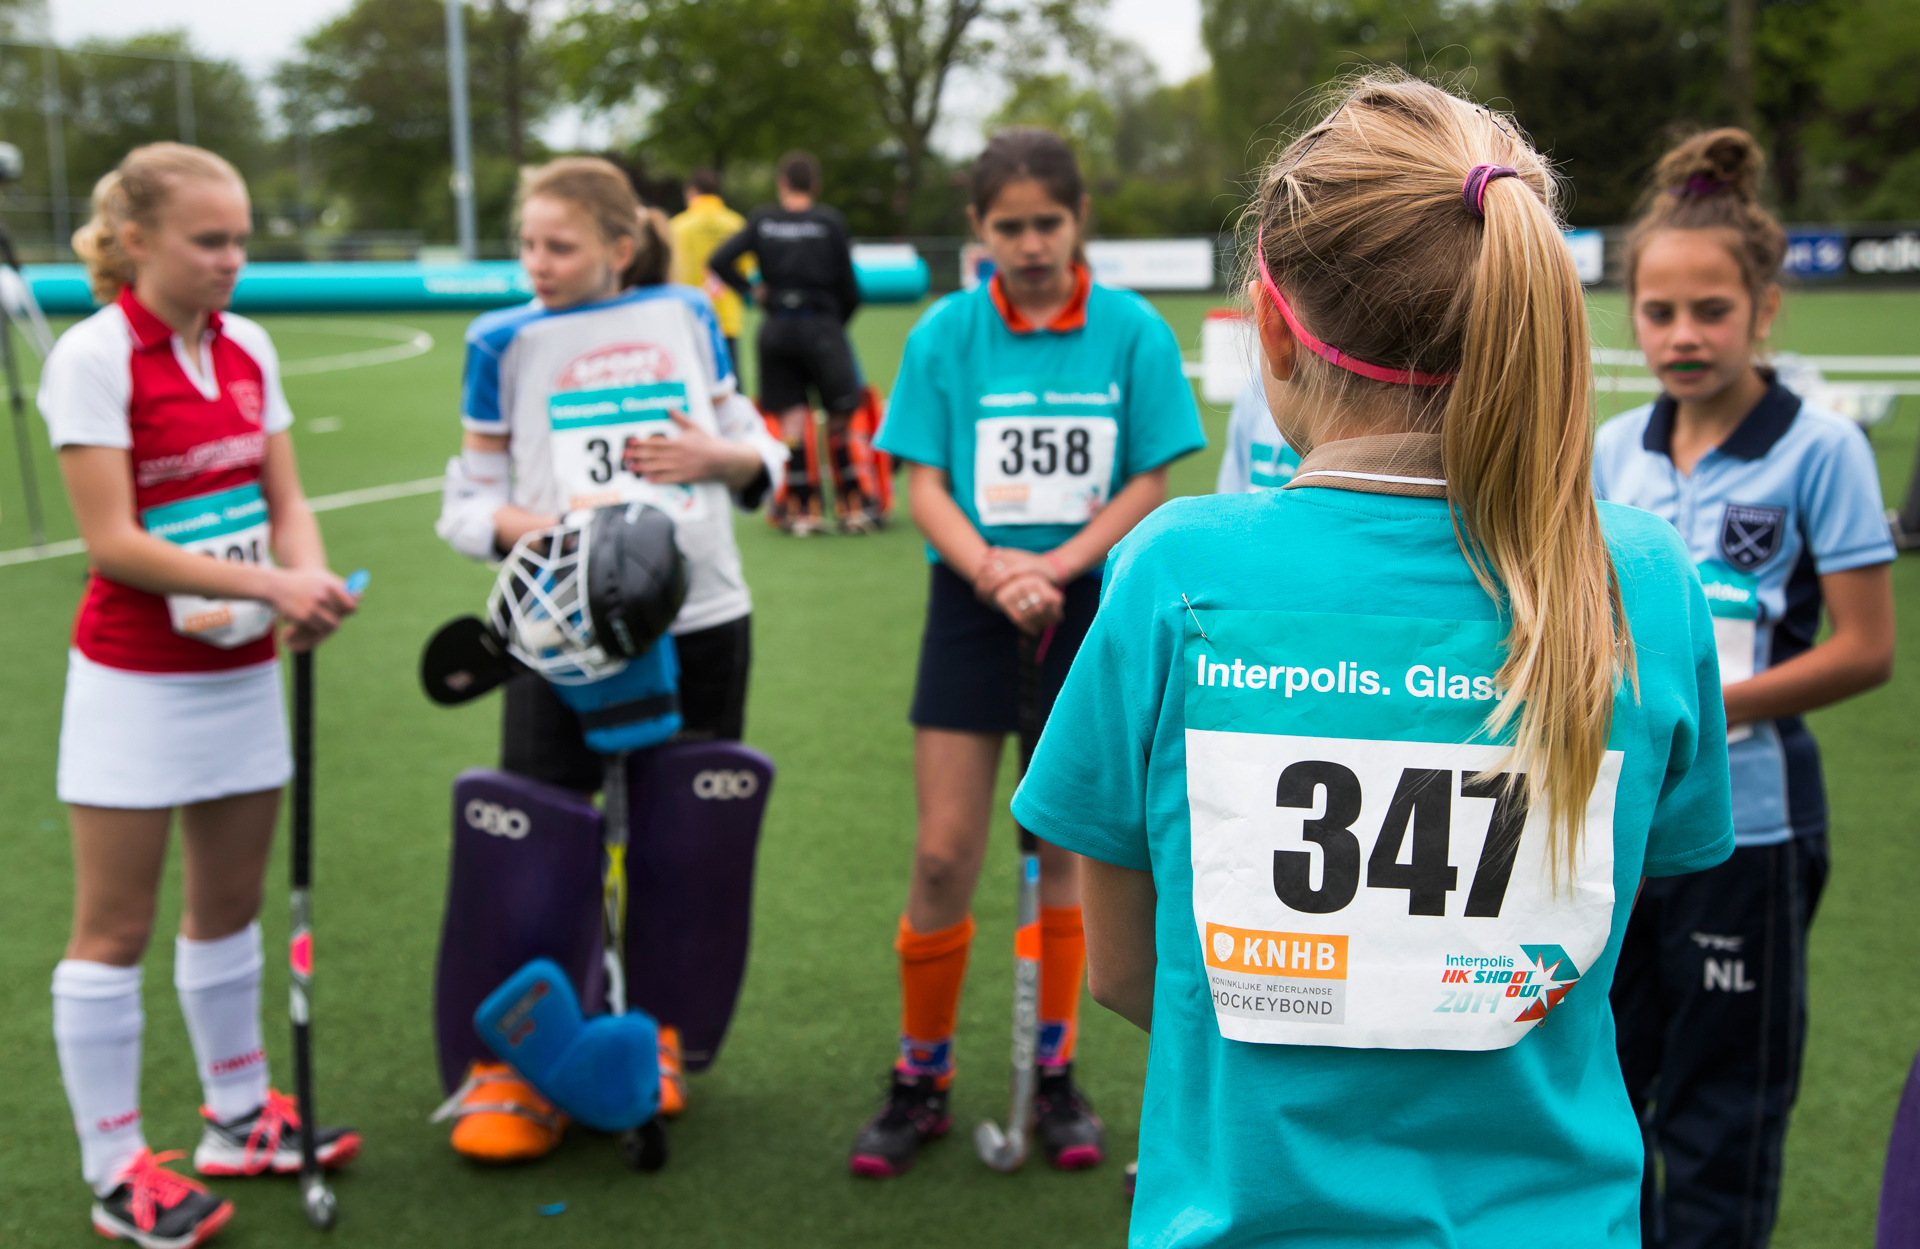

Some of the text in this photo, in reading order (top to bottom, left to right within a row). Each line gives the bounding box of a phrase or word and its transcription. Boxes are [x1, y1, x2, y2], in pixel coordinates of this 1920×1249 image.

[1001, 428, 1090, 476] 358
[1197, 654, 1391, 698] Interpolis.
[1273, 760, 1531, 918] 347
[1243, 937, 1336, 971] KNHB
[1446, 954, 1514, 969] Interpolis
[1212, 976, 1333, 996] KONINKLIJKE NEDERLANDSE
[1441, 970, 1537, 984] NK SHOOT
[1704, 957, 1756, 993] NL
[1212, 989, 1333, 1016] HOCKEYBOND
[1432, 990, 1503, 1014] 2014
[1505, 985, 1544, 998] OUT
